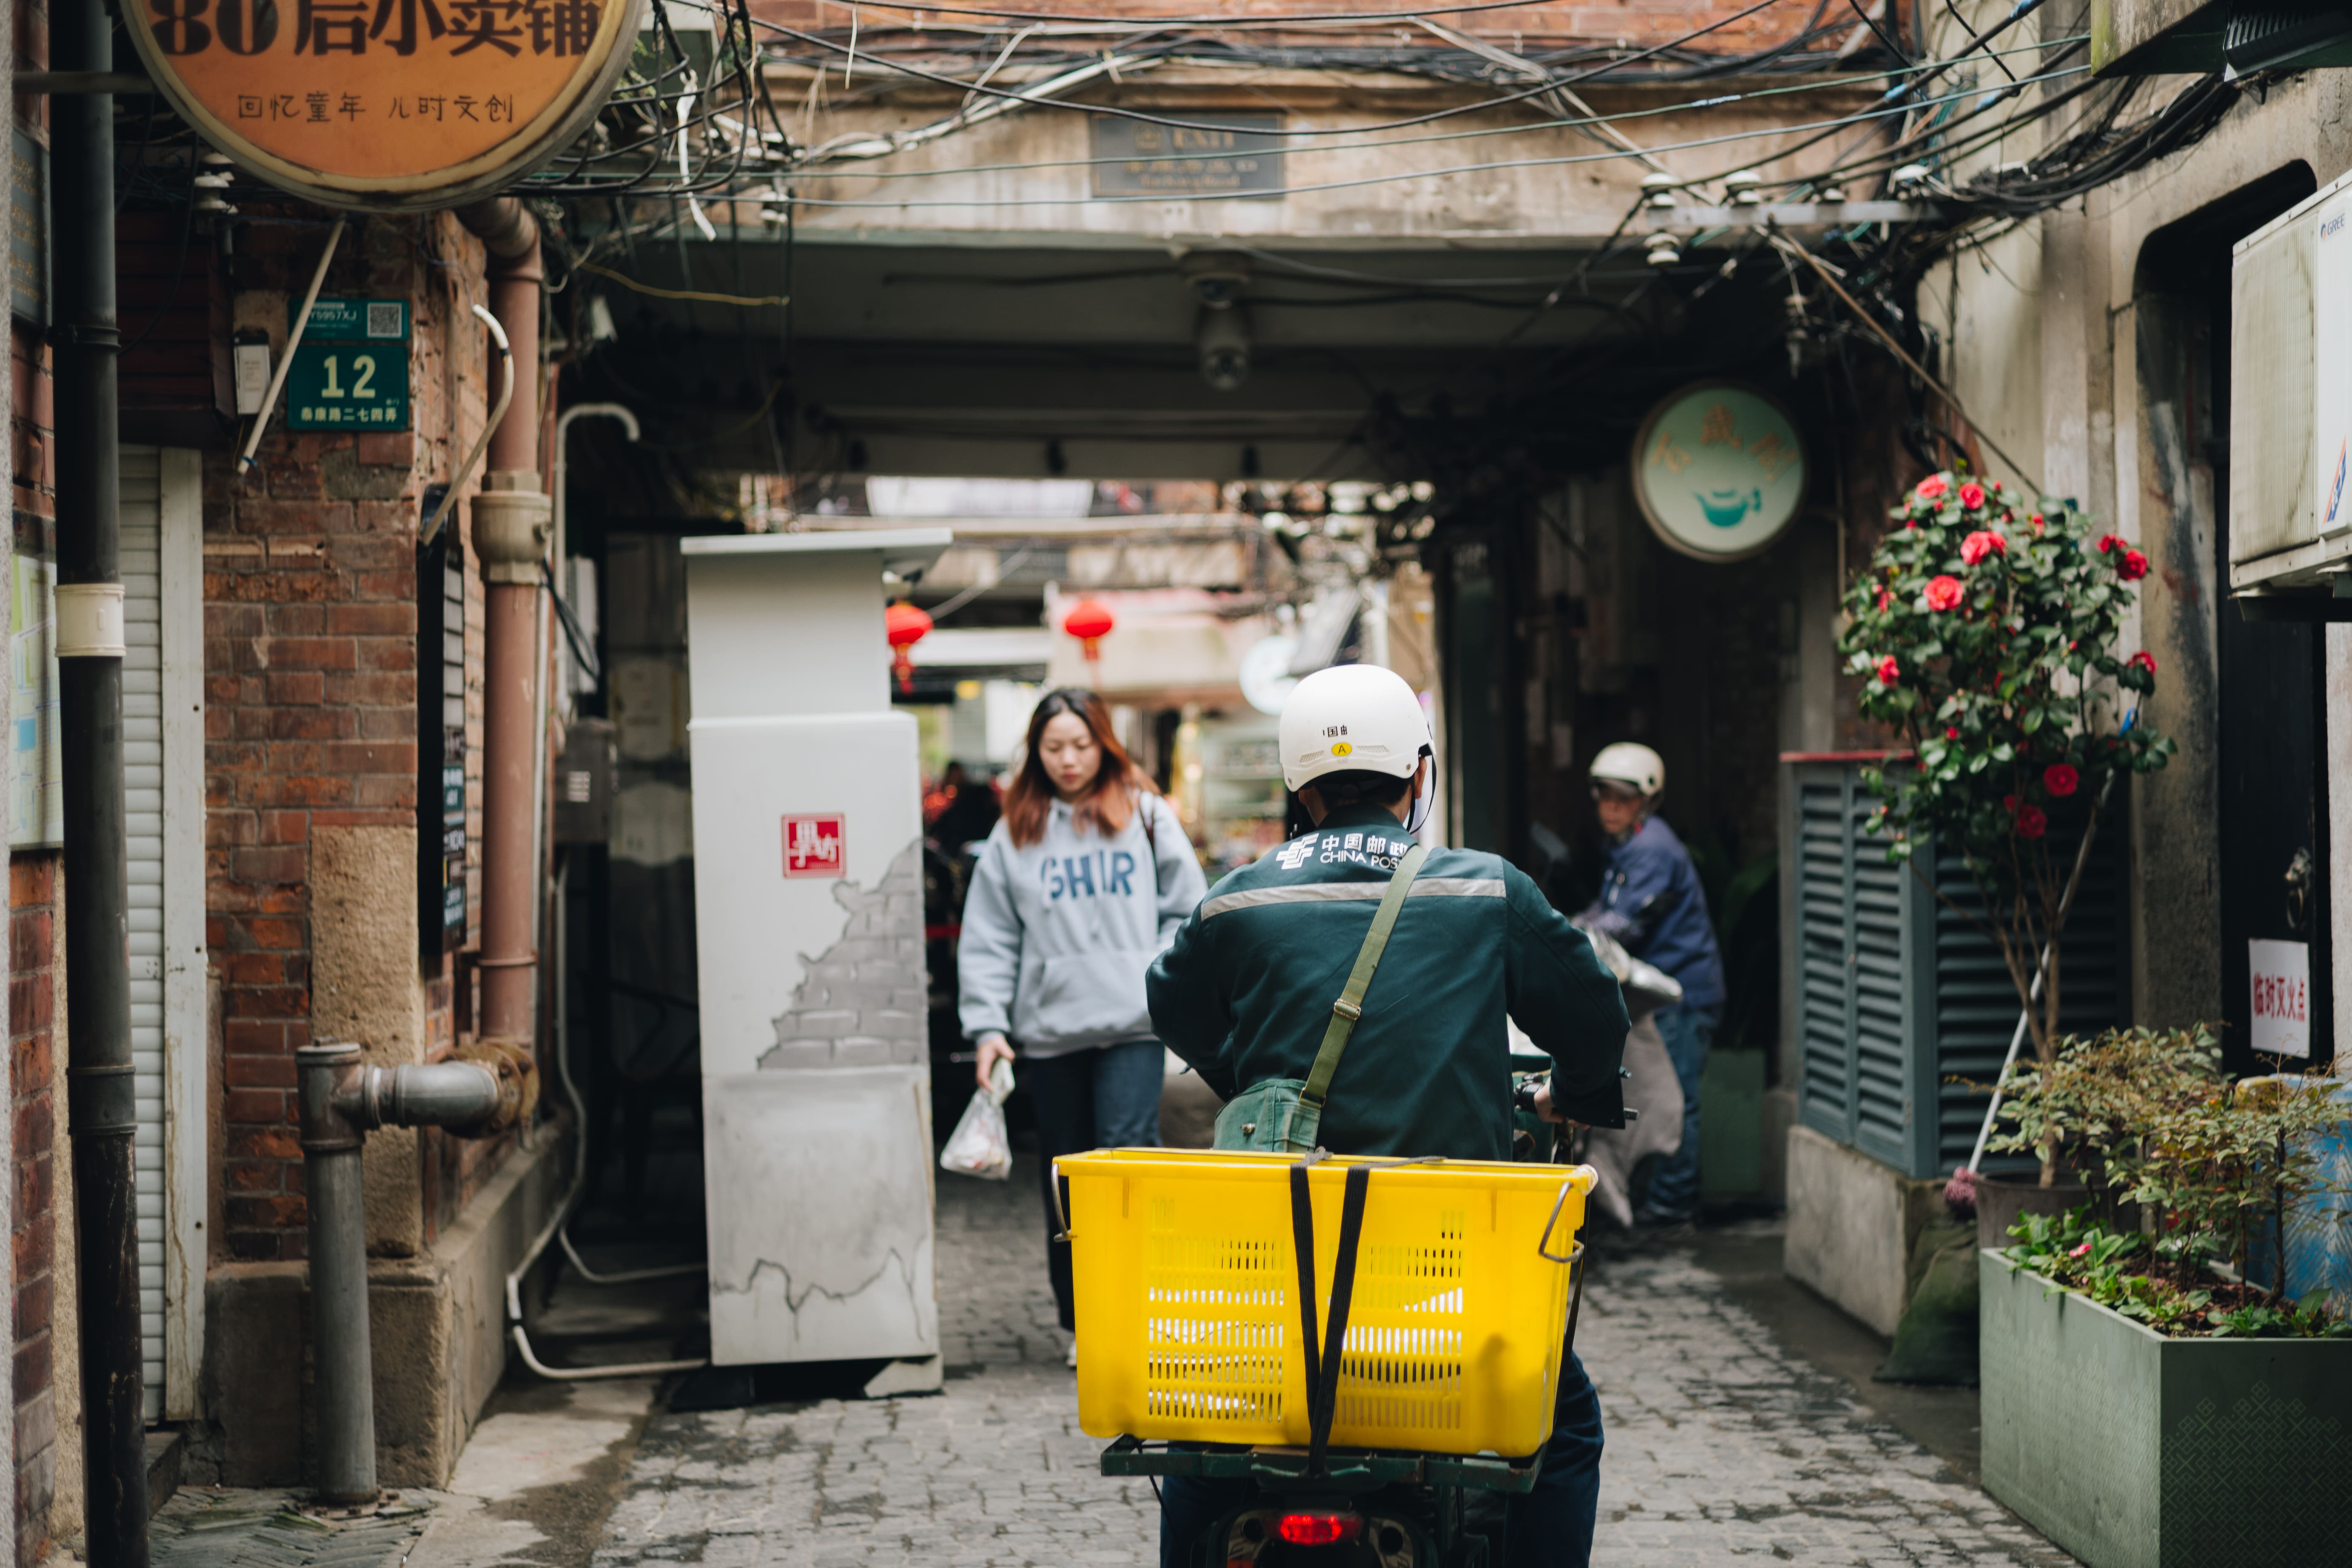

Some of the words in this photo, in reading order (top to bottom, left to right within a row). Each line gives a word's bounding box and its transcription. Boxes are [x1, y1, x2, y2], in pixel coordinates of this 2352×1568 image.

[238, 91, 366, 123] 回忆童年
[388, 93, 513, 123] 儿时文创
[2327, 213, 2345, 236] GREE
[322, 355, 376, 398] 12
[1338, 745, 1346, 754] A
[1322, 833, 1409, 857] 中国邮政
[1320, 850, 1367, 864] CHINA
[1371, 855, 1402, 869] POS
[2253, 972, 2305, 1023] 临时灭火点
